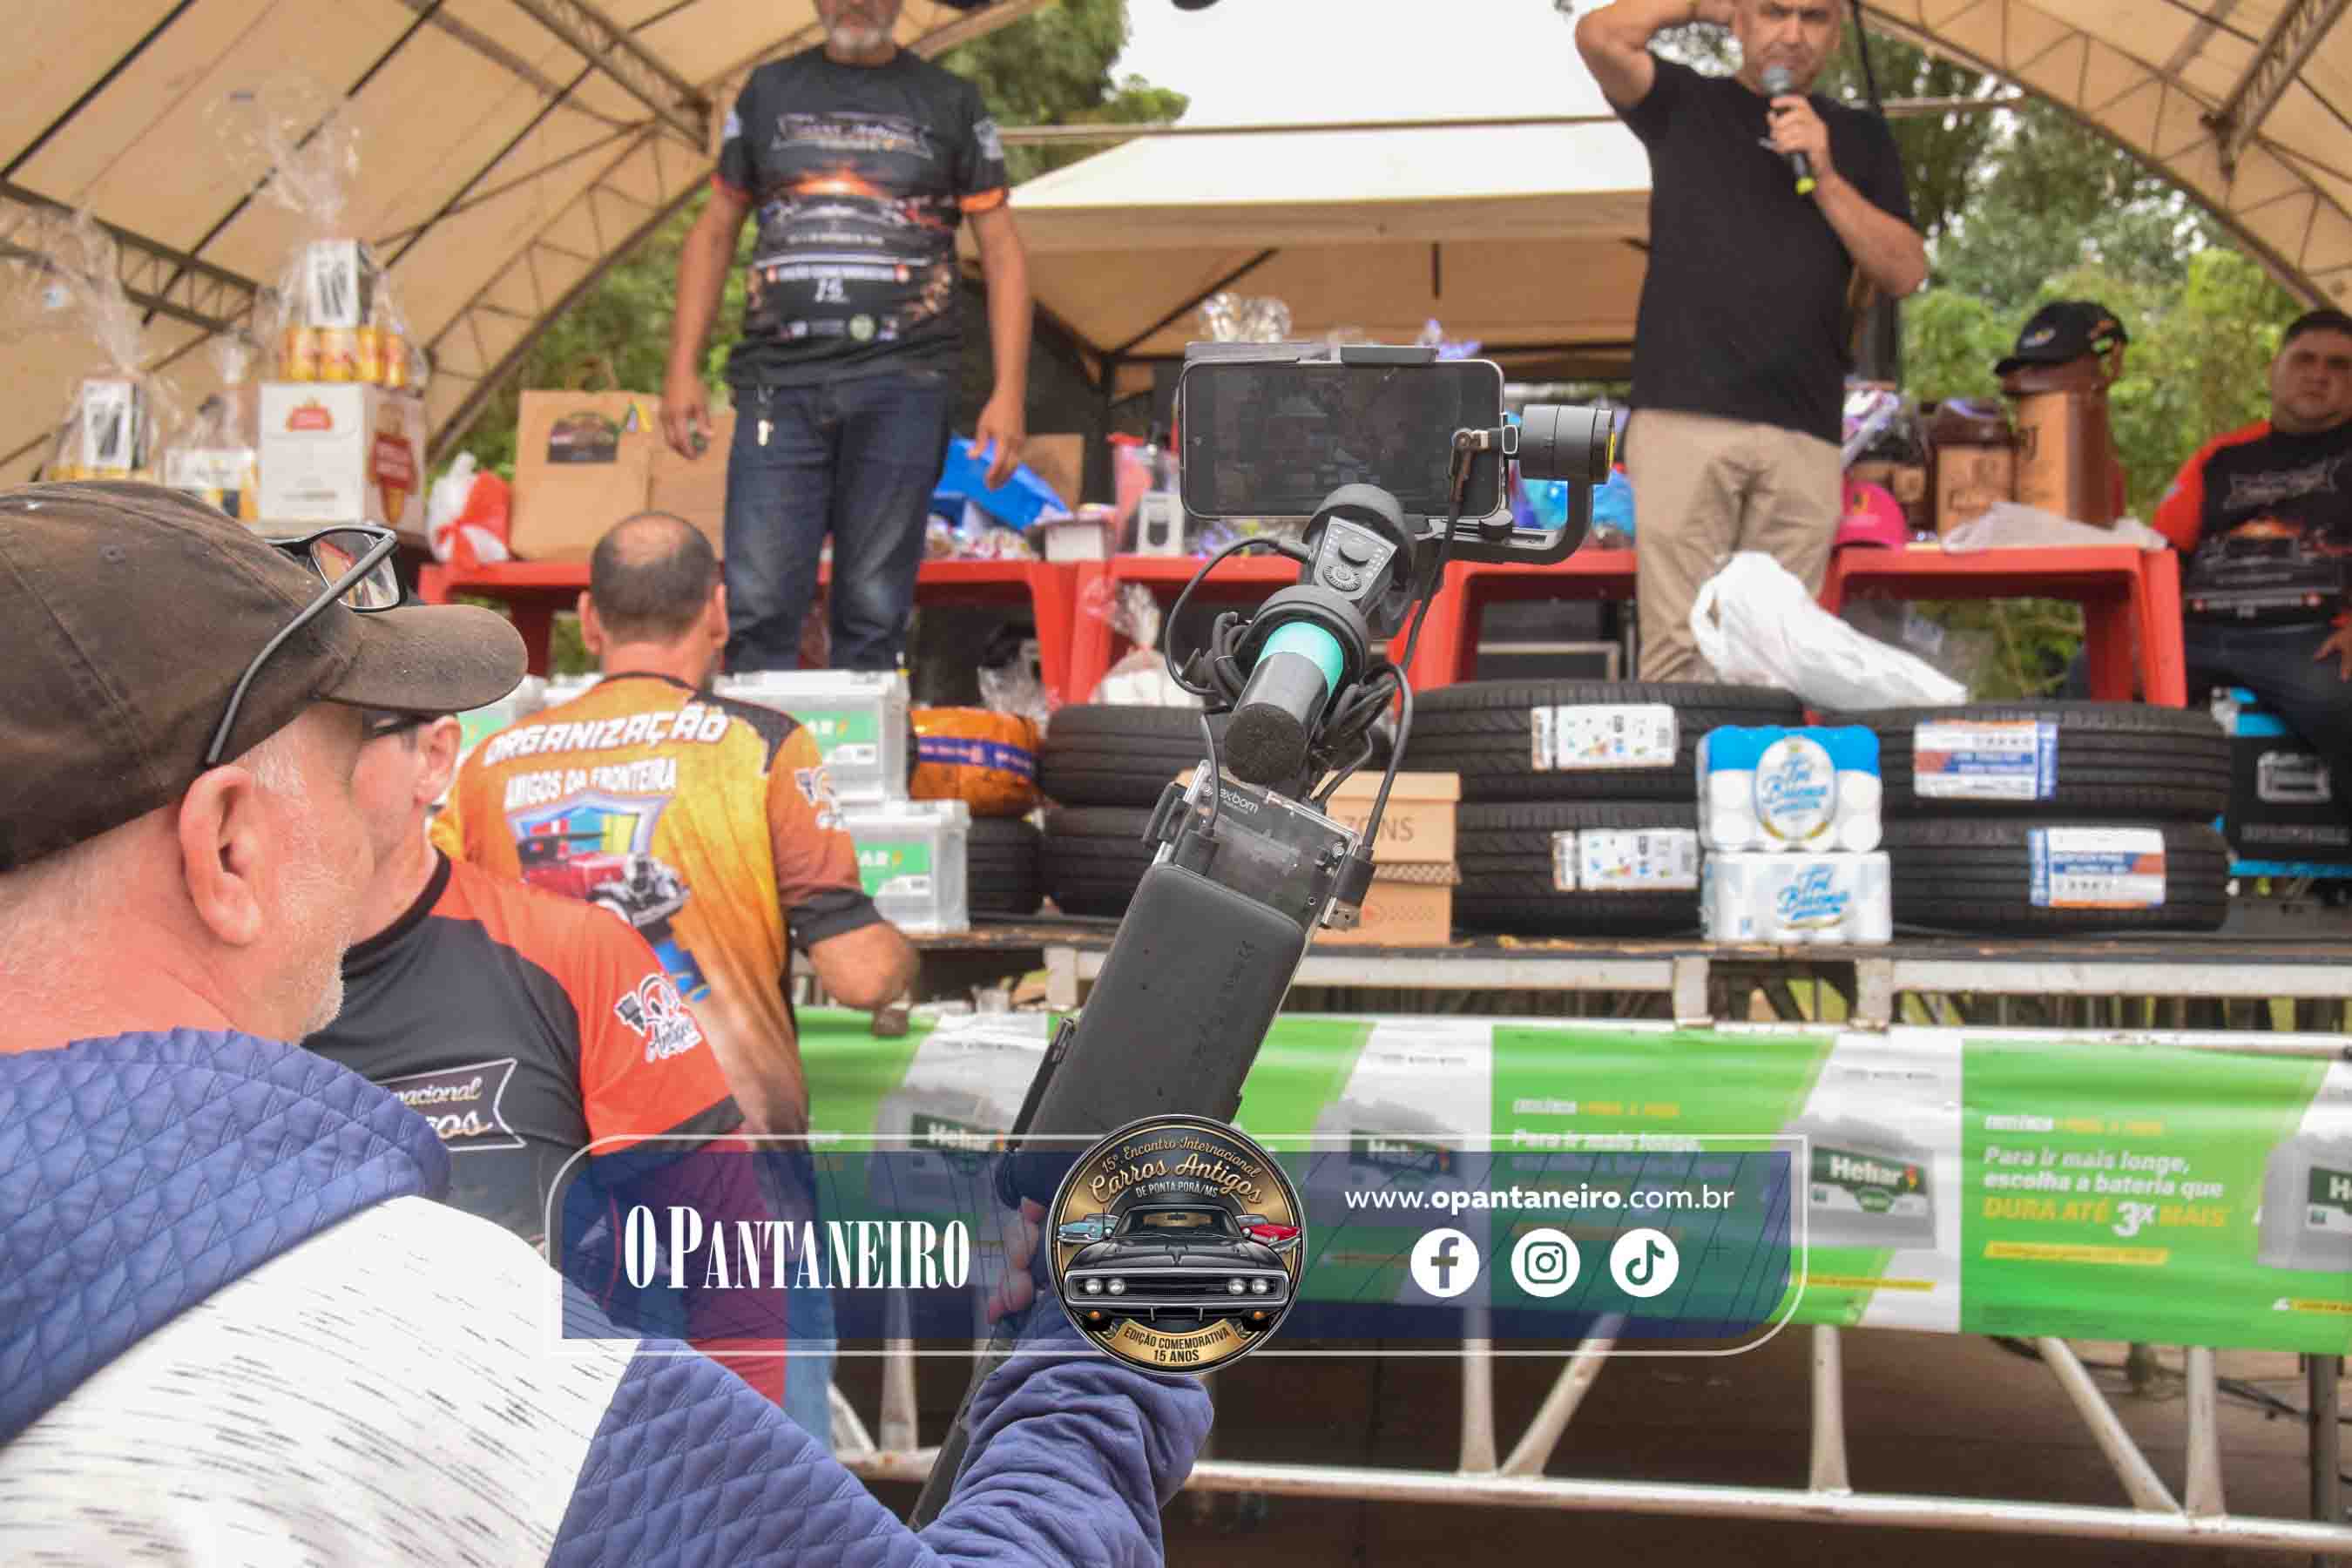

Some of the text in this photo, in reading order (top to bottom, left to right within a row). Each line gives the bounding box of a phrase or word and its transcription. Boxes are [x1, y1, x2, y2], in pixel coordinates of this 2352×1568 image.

[483, 702, 728, 767] ORGANIZAÇÃO
[1983, 1145, 2190, 1175] Para ir mais longe,
[1984, 1171, 2224, 1200] escolha a bateria que
[1983, 1197, 2057, 1220] DURA
[2062, 1198, 2110, 1224] ATÉ
[2159, 1206, 2230, 1227] MAIS
